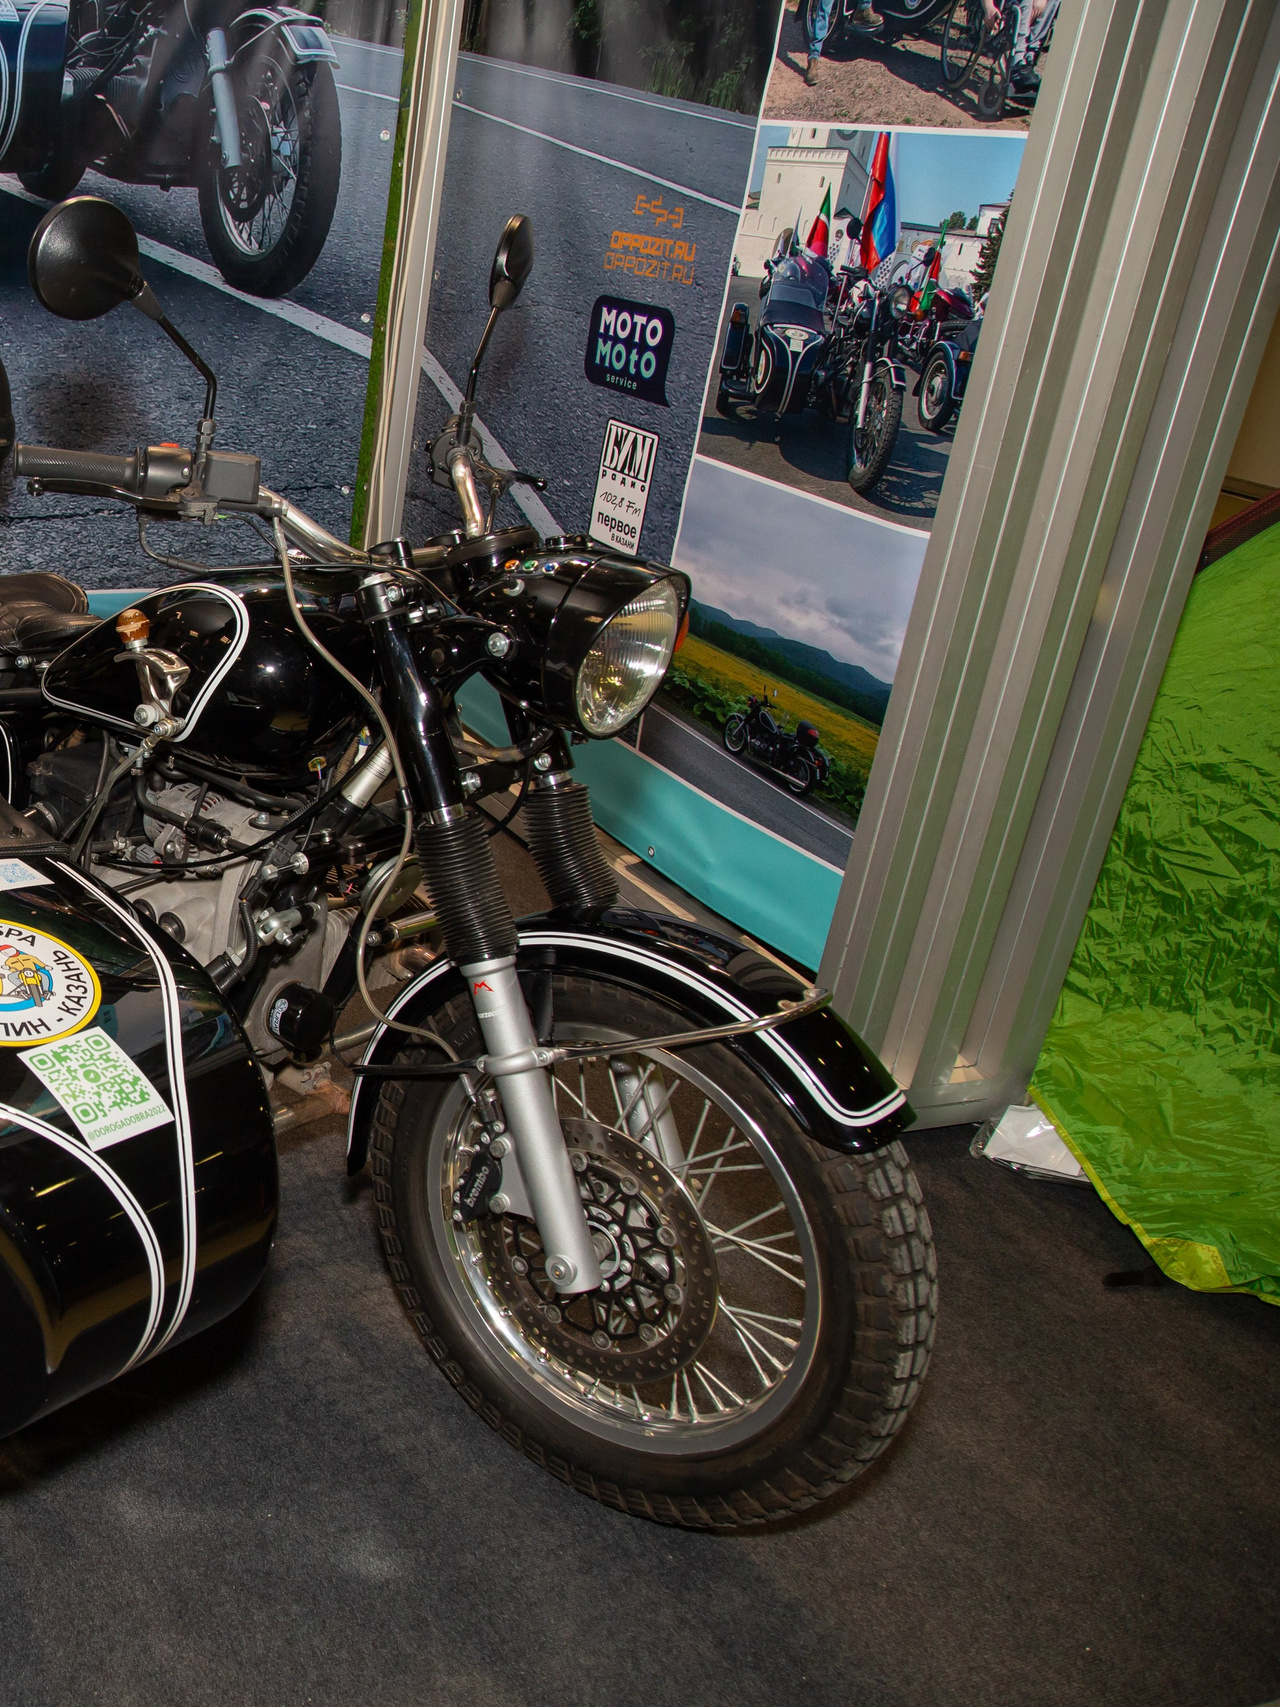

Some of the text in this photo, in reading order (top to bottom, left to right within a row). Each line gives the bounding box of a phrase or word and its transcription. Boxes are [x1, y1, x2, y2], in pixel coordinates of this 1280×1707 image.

[610, 230, 697, 262] OPPOZIT.RU
[603, 252, 695, 285] OPPOZIT.RU
[599, 307, 663, 347] MOTO
[606, 373, 637, 390] service
[602, 424, 656, 483] БИМ
[602, 469, 646, 492] радио
[600, 491, 625, 511] 102,8
[597, 511, 637, 539] первое
[615, 535, 635, 550] КАЗАНИ
[52, 949, 88, 1018] КАЗАНЬ
[87, 1104, 167, 1141] @DOROGADOBRA2022
[464, 1165, 490, 1208] brembo
